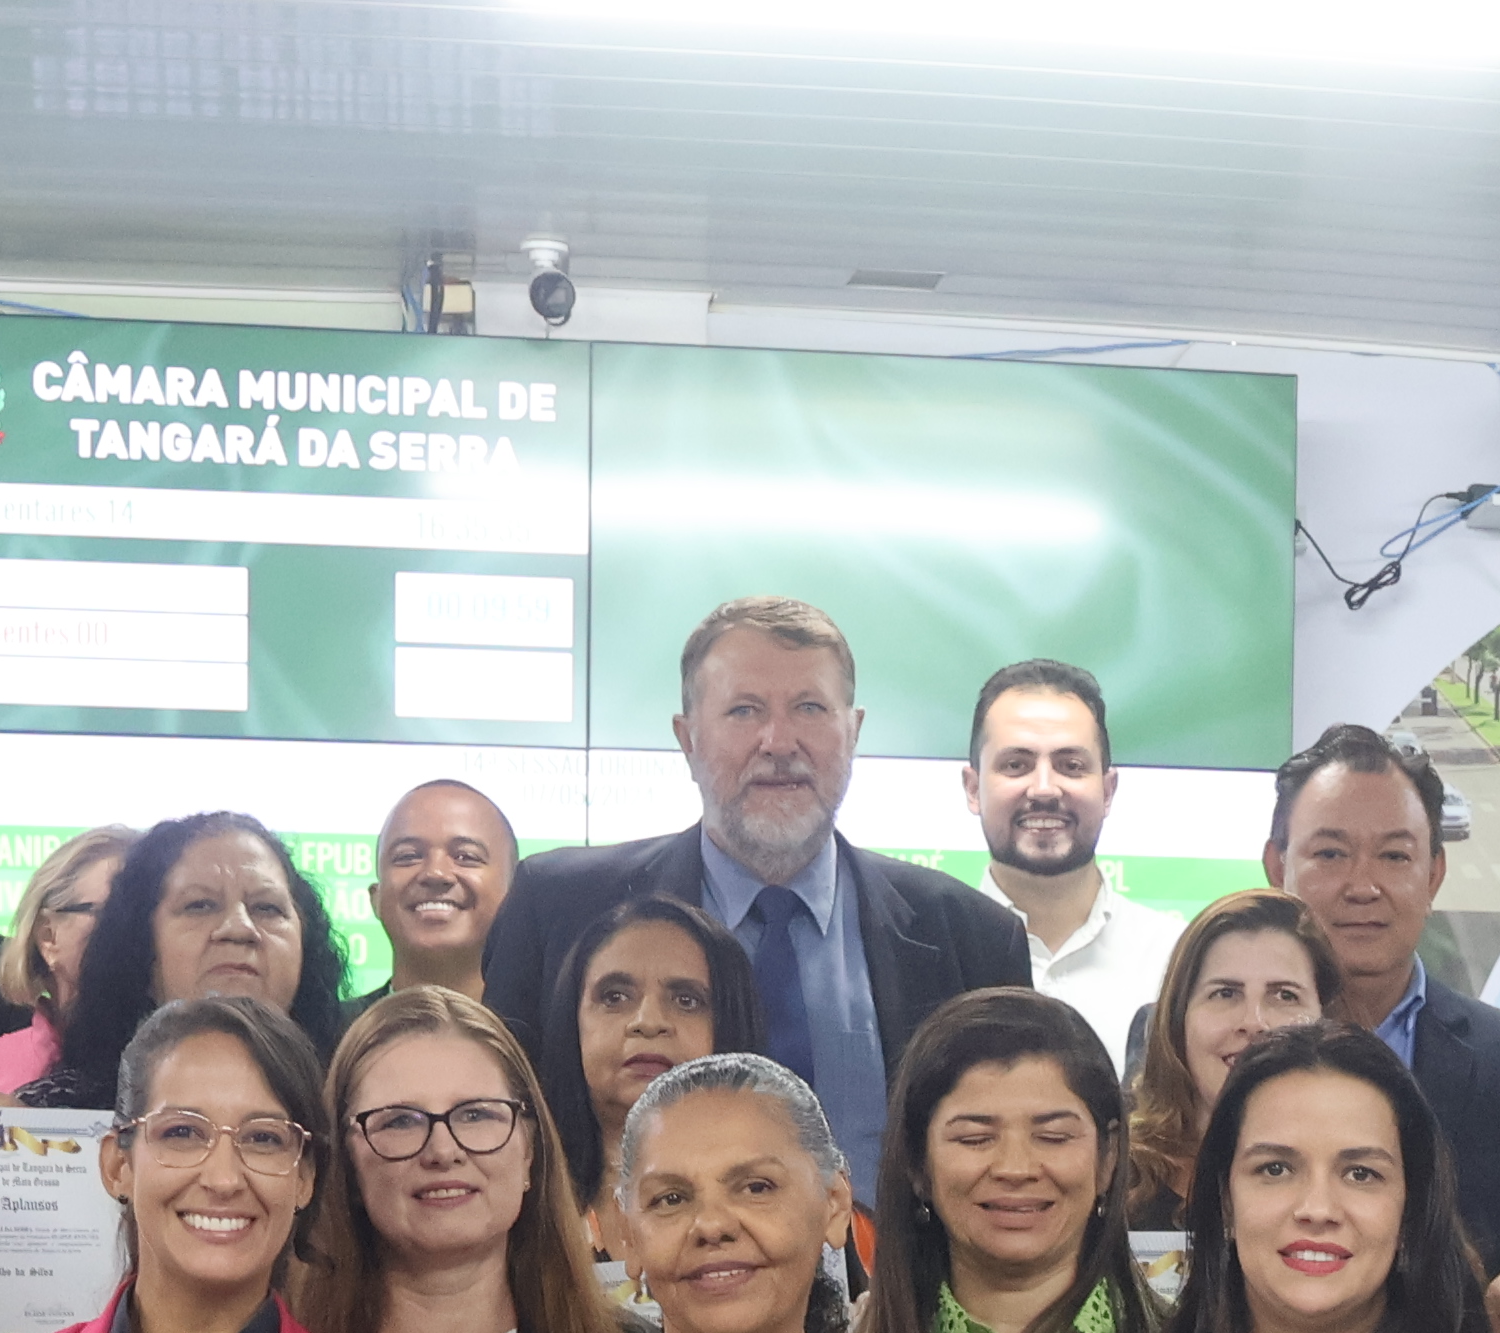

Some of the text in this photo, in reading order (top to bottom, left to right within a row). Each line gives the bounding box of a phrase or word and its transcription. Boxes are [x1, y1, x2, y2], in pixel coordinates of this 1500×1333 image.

[33, 352, 557, 422] CÂMARA MUNICIPAL DE
[70, 416, 521, 474] TANGARÁ DA SERRA
[108, 501, 135, 526] 14
[76, 619, 109, 647] 00
[2, 1197, 58, 1214] Aplausos
